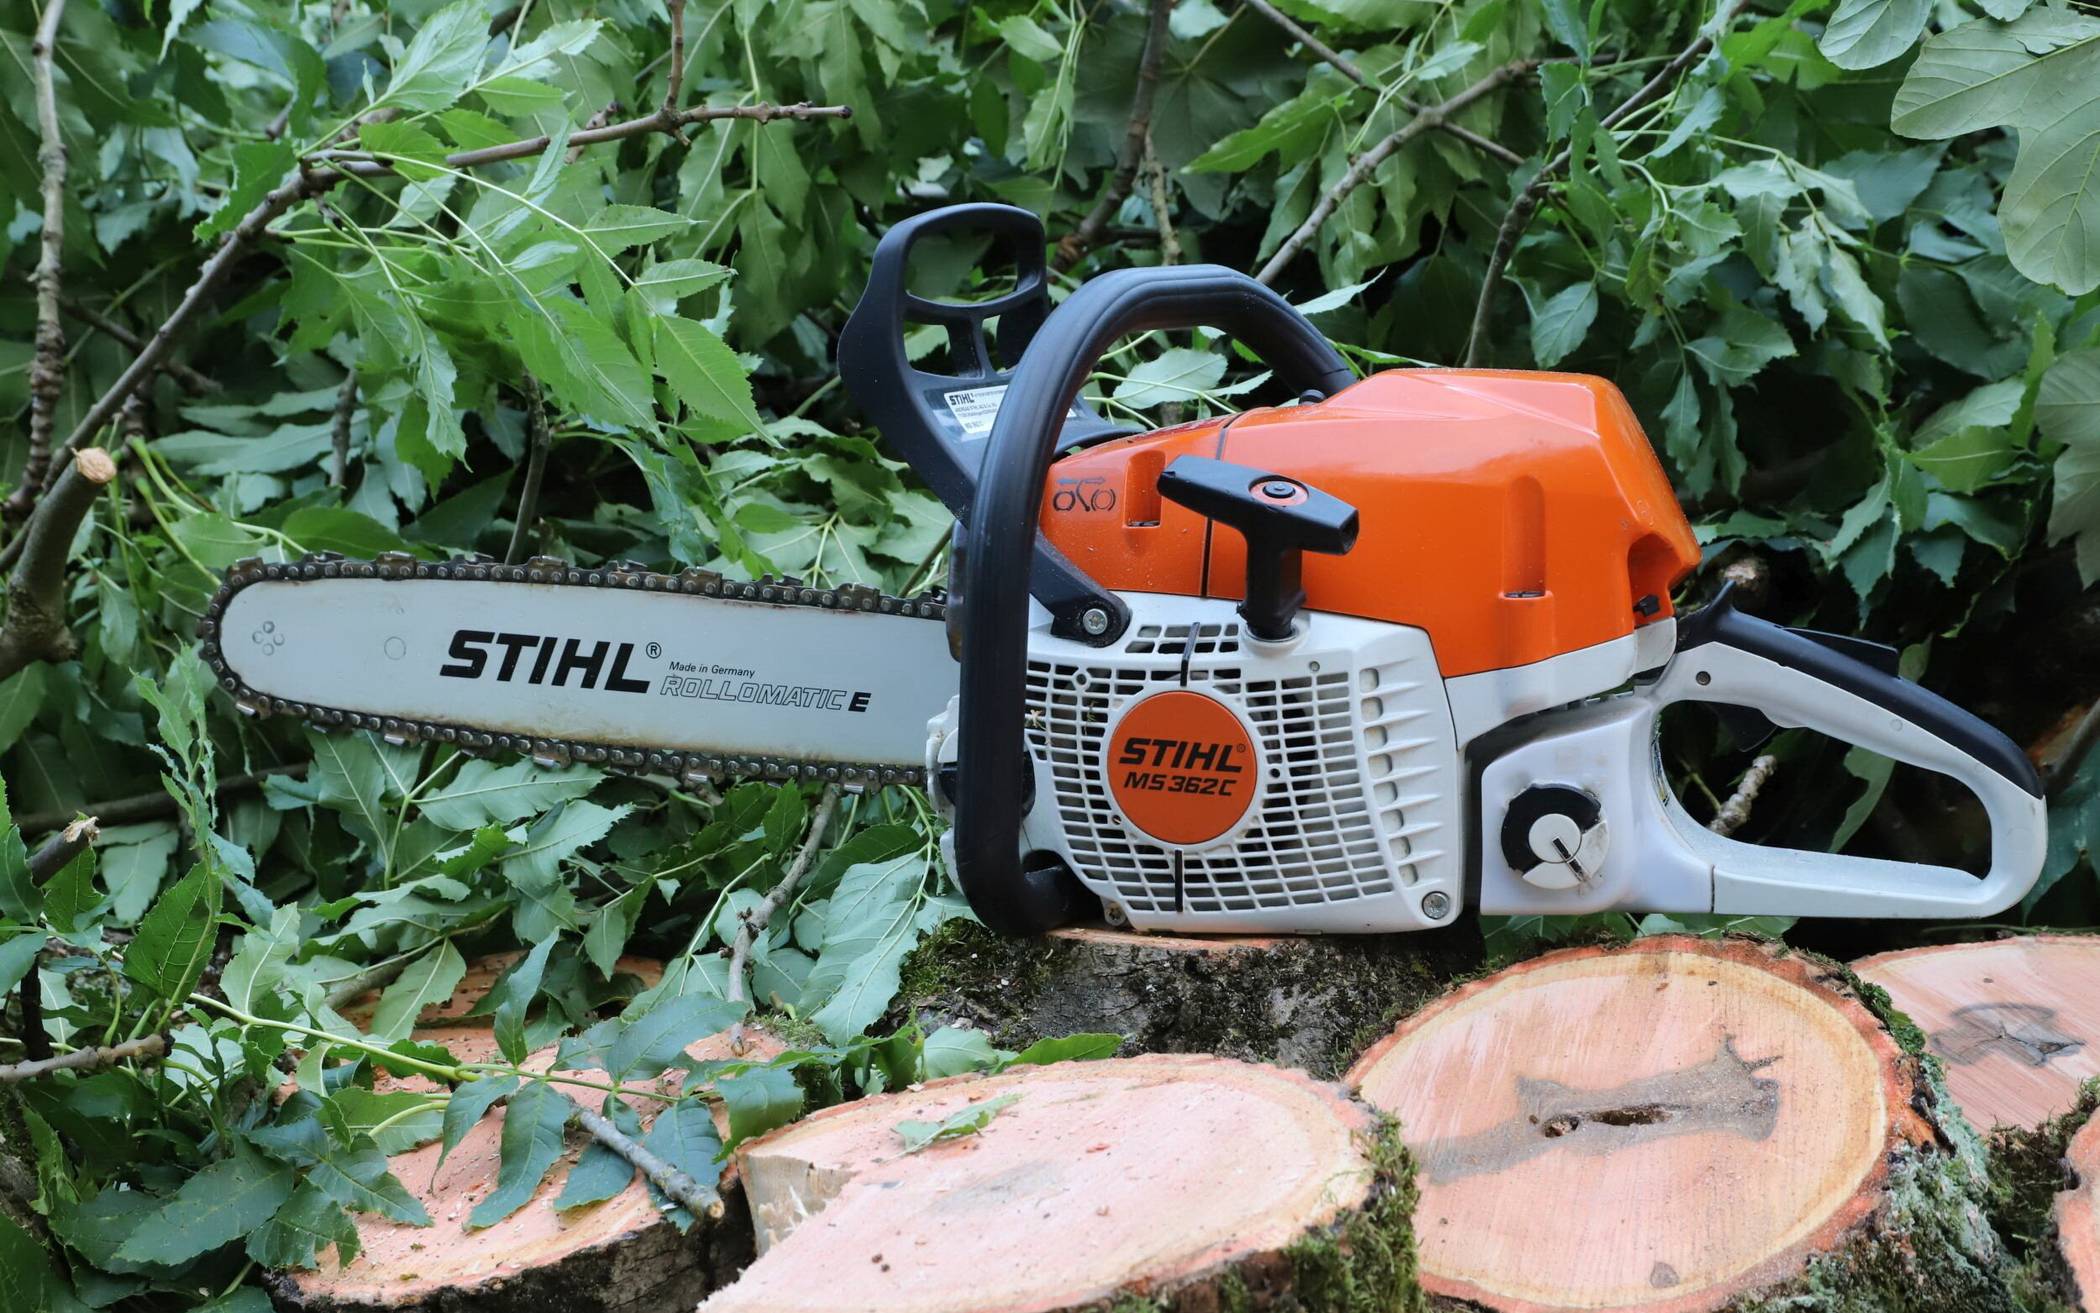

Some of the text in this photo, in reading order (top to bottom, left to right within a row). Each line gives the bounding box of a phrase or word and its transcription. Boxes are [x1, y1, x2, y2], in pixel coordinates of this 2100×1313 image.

[669, 661, 756, 679] Made in Germany
[660, 675, 872, 713] ROLLOMATIC E
[1123, 771, 1167, 791] MS
